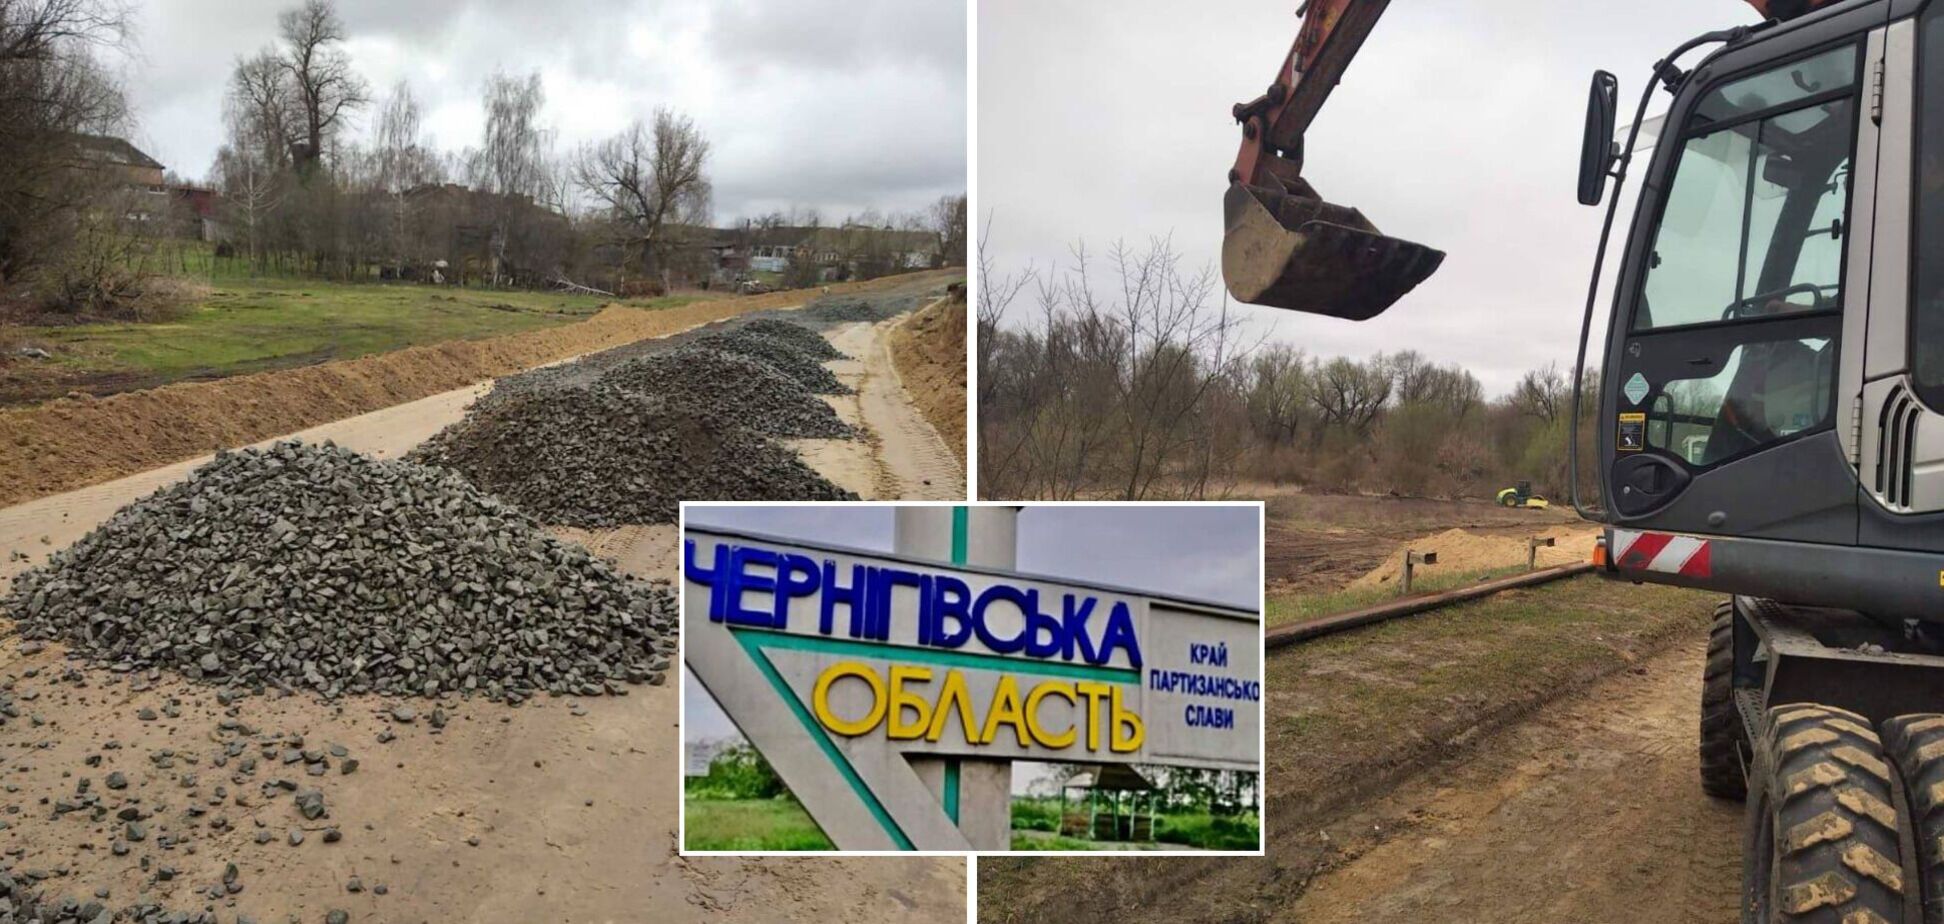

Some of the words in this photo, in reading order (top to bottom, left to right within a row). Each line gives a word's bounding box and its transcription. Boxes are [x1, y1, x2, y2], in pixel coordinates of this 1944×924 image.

[684, 538, 1143, 669] ЧЕРНІГІВСЬКА
[1190, 642, 1228, 668] КРАЙ
[812, 661, 1145, 754] ОБЛАСТЬ
[1185, 704, 1234, 730] СЛАВИ
